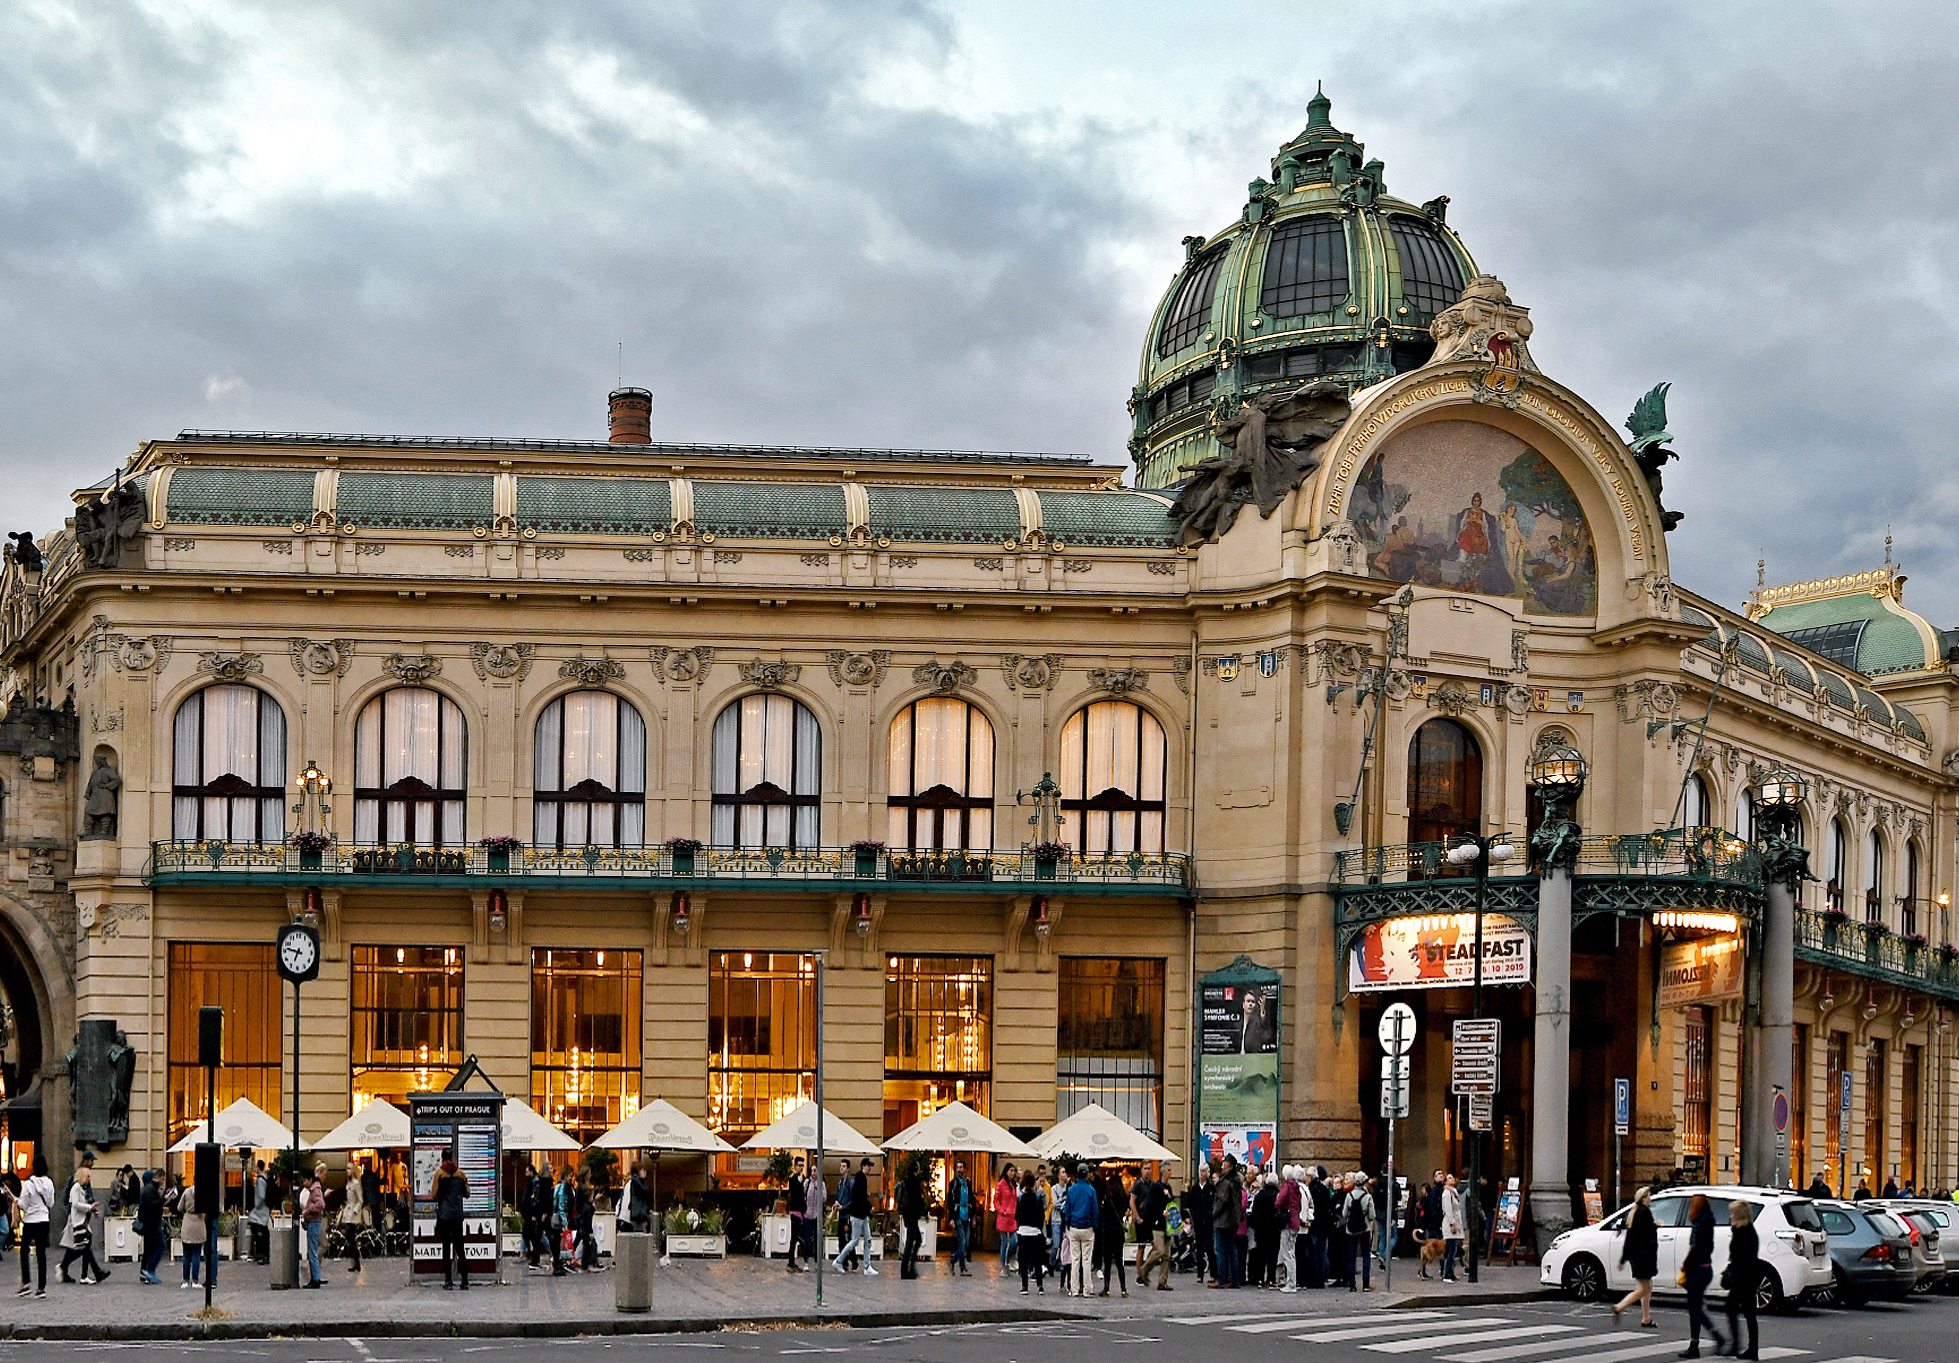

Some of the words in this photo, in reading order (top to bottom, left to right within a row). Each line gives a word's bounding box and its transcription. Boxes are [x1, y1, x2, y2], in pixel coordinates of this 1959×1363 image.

[1427, 938, 1524, 963] STEADFAST
[1505, 963, 1524, 971] 2019
[1619, 1085, 1626, 1110] P
[421, 1106, 438, 1114] TRIPS
[440, 1106, 453, 1114] OUT
[454, 1106, 464, 1114] OF
[464, 1106, 491, 1114] PRAGUE
[464, 1248, 489, 1256] TOUR
